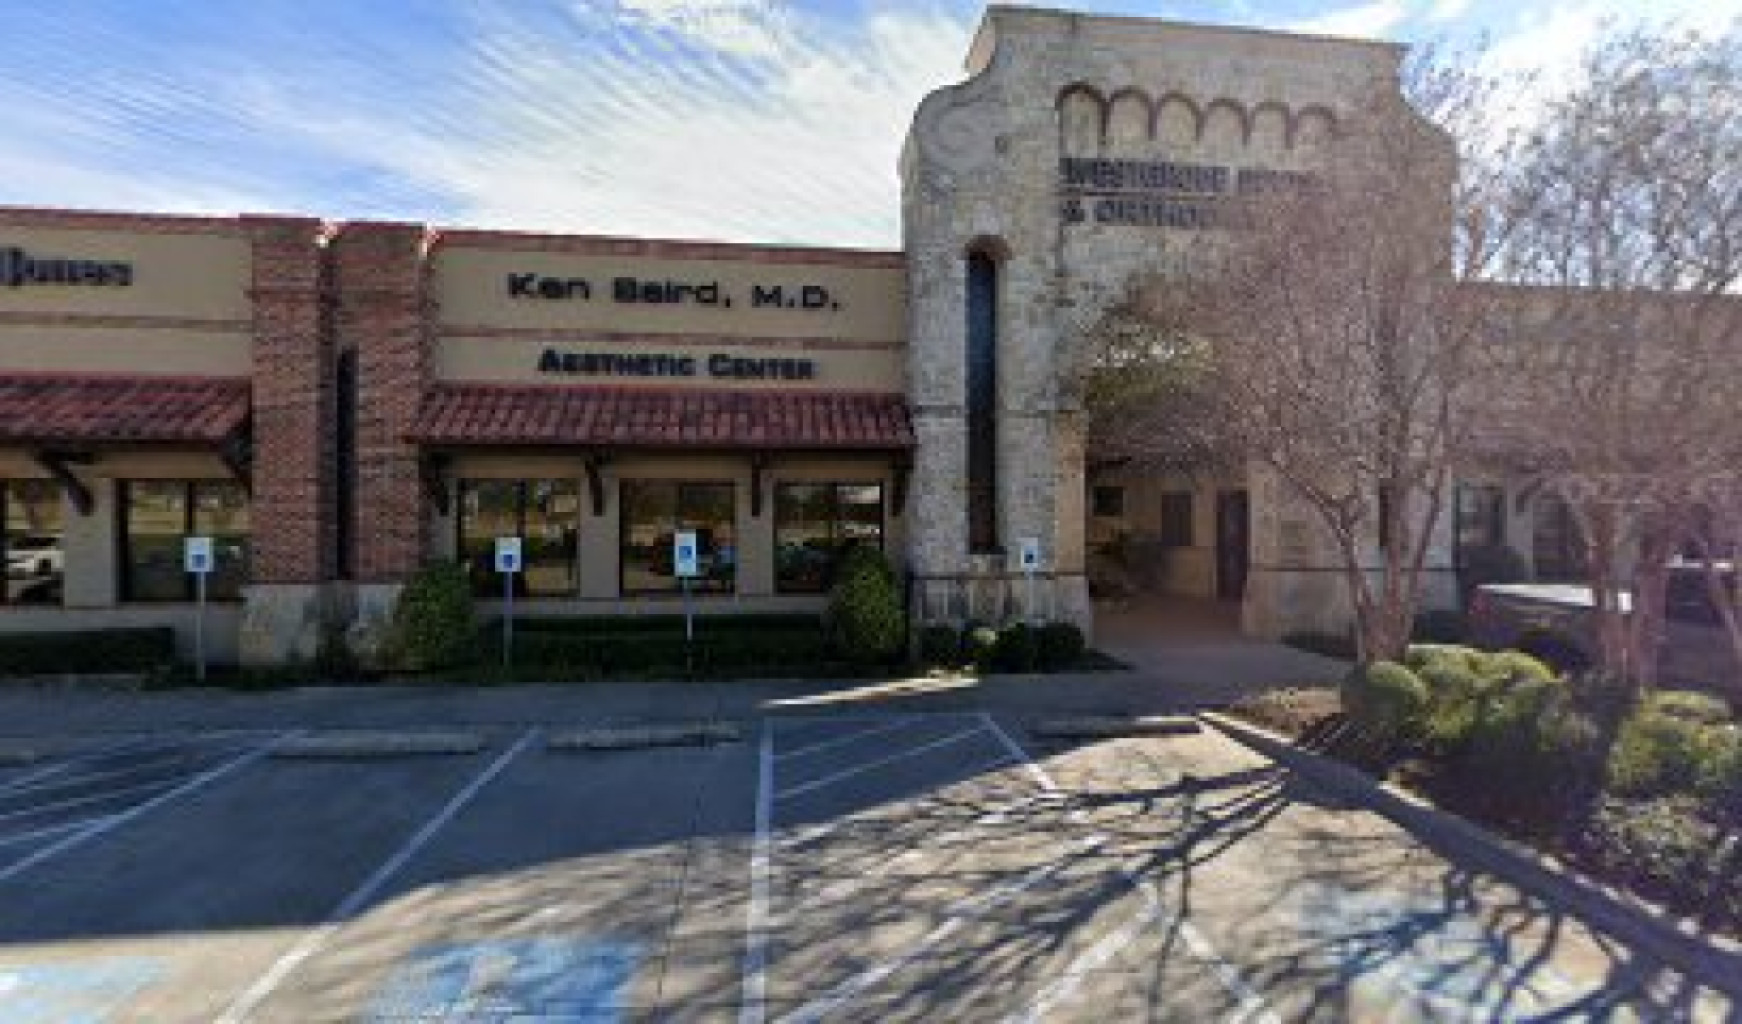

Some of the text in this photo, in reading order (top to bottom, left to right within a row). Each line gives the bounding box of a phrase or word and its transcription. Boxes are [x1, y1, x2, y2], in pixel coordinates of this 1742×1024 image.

[508, 273, 840, 309] Ken Baird, M.D.
[538, 350, 814, 379] AESTHETIC CENTER
